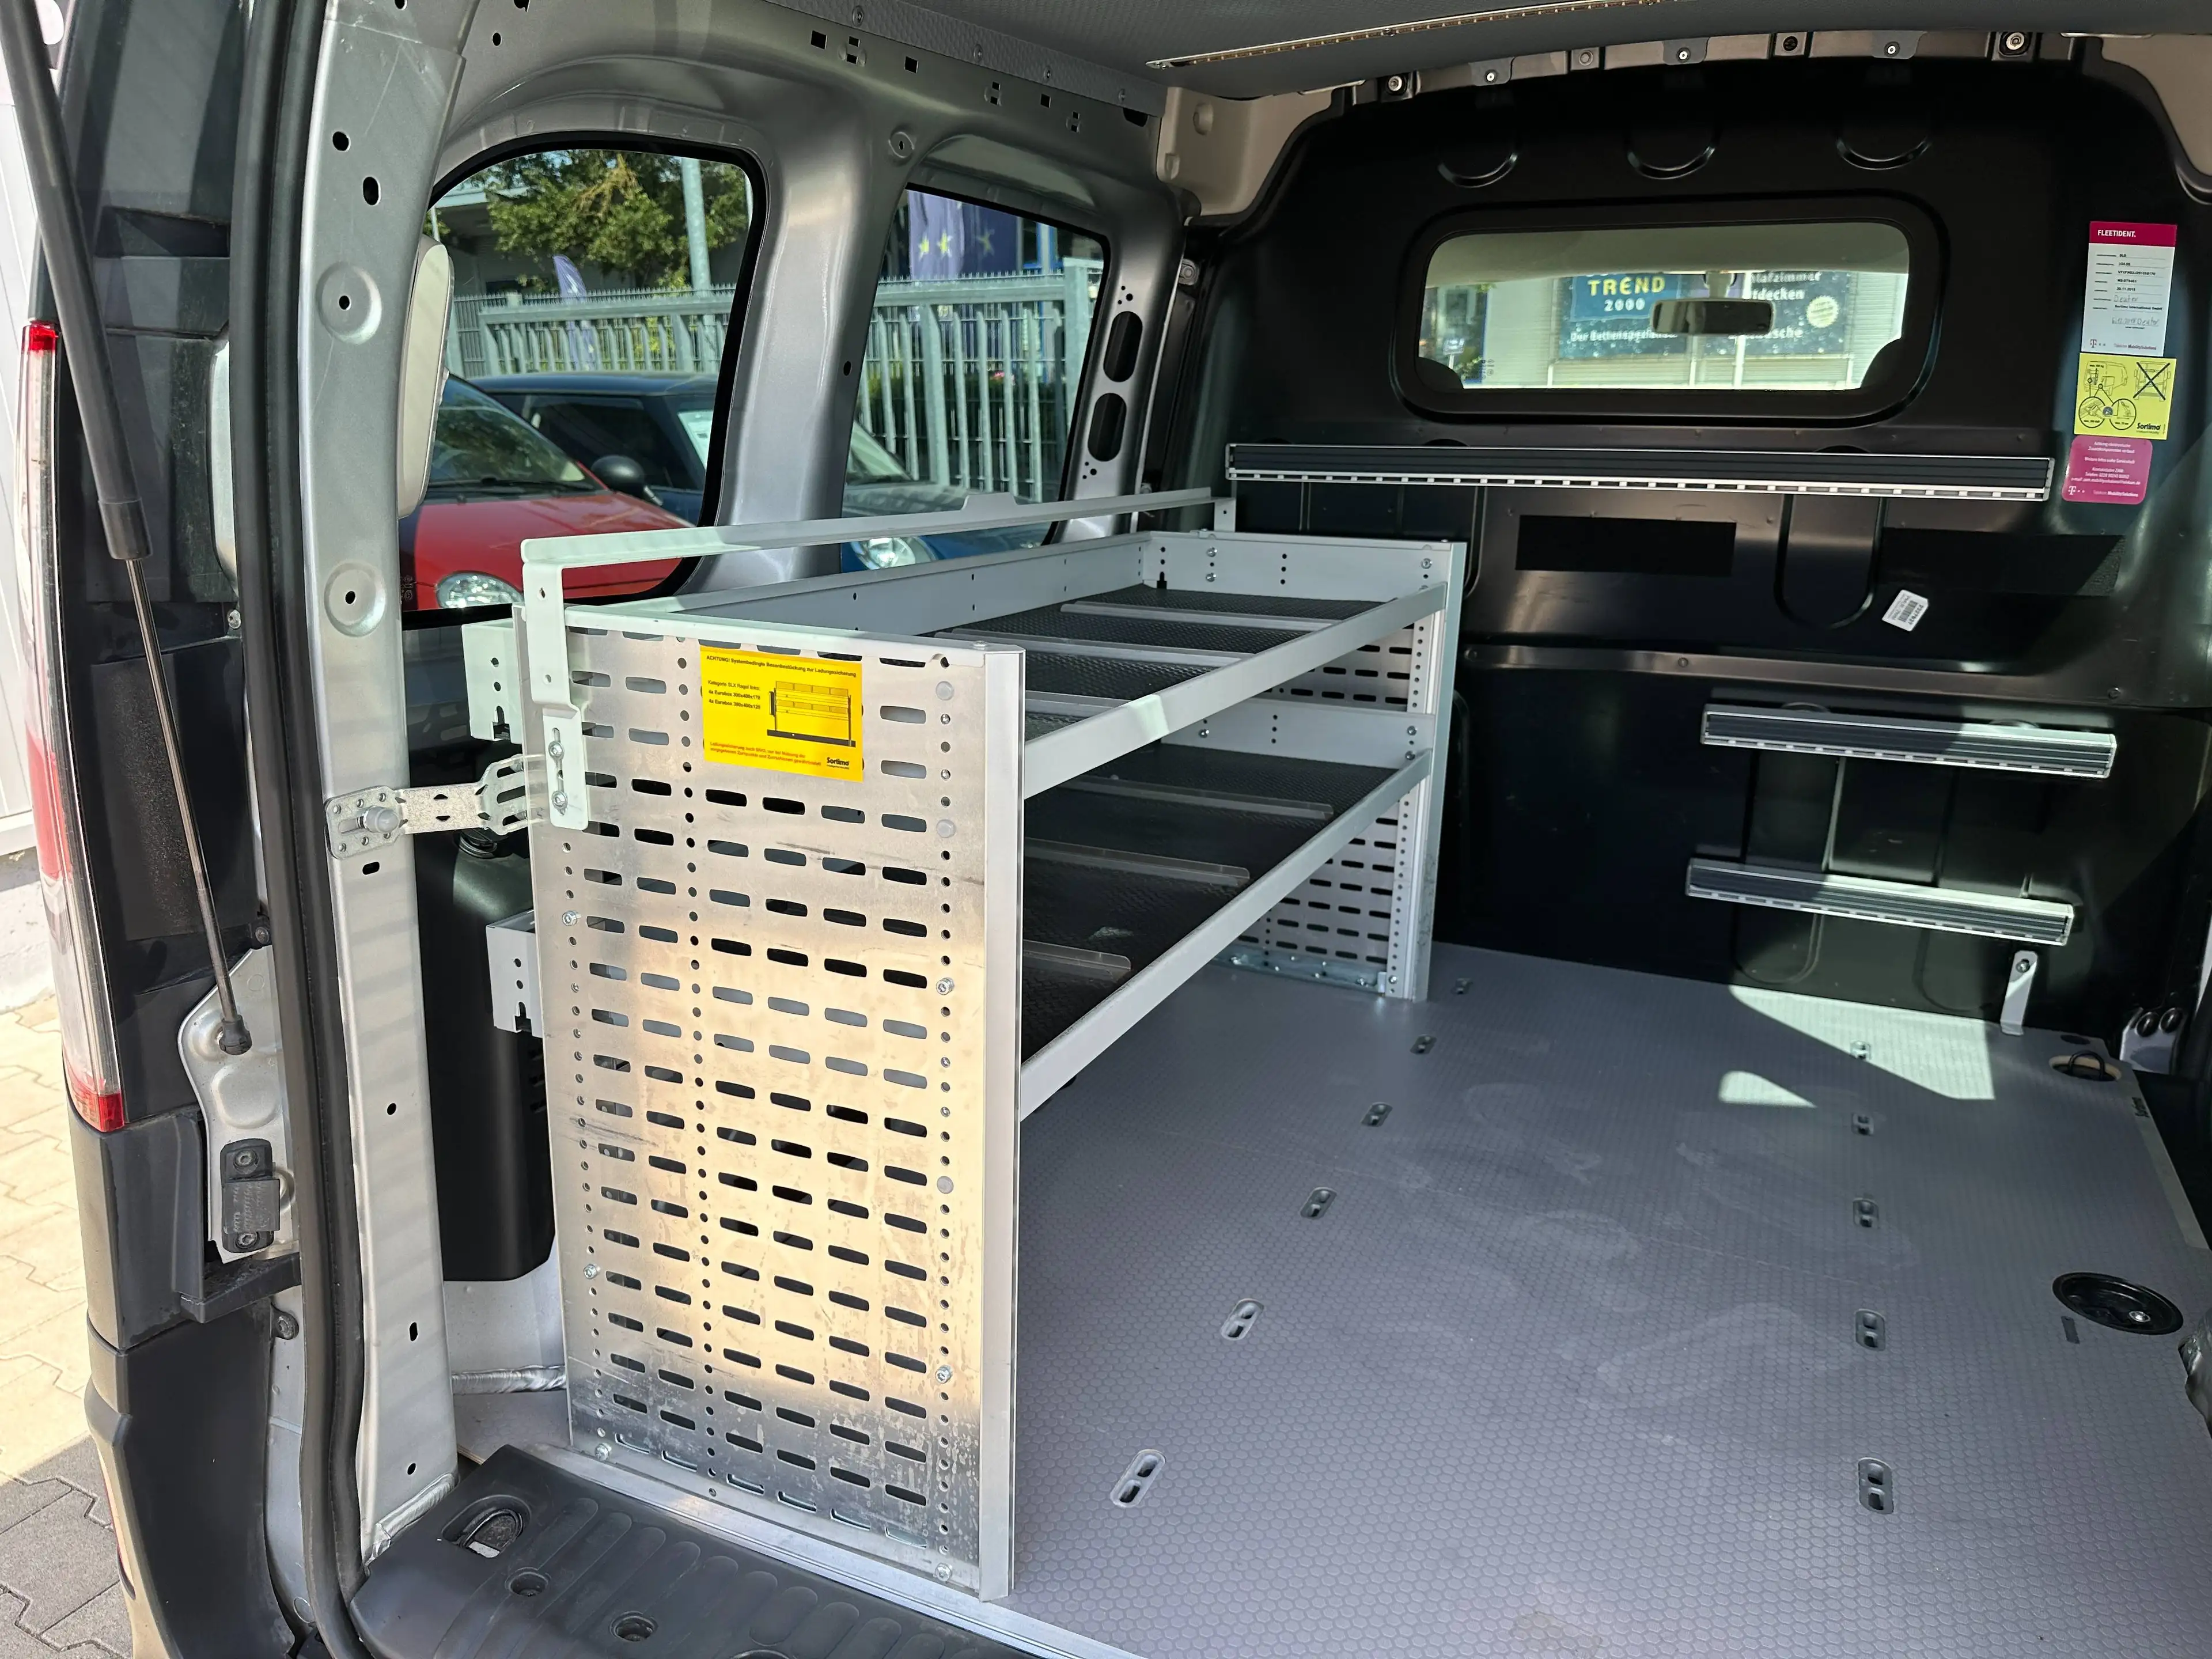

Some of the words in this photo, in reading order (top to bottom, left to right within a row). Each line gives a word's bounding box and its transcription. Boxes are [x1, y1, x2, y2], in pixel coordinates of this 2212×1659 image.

[2097, 229, 2136, 237] FLEETIDENT.
[1588, 276, 1666, 296] TREND
[1751, 287, 1805, 301] tdecken
[1604, 297, 1646, 312] 2000
[2137, 422, 2161, 430] Sortimo
[730, 658, 766, 667] Systembedingte
[815, 668, 857, 678] Ladungssicherung
[827, 756, 850, 766] Sortimo
